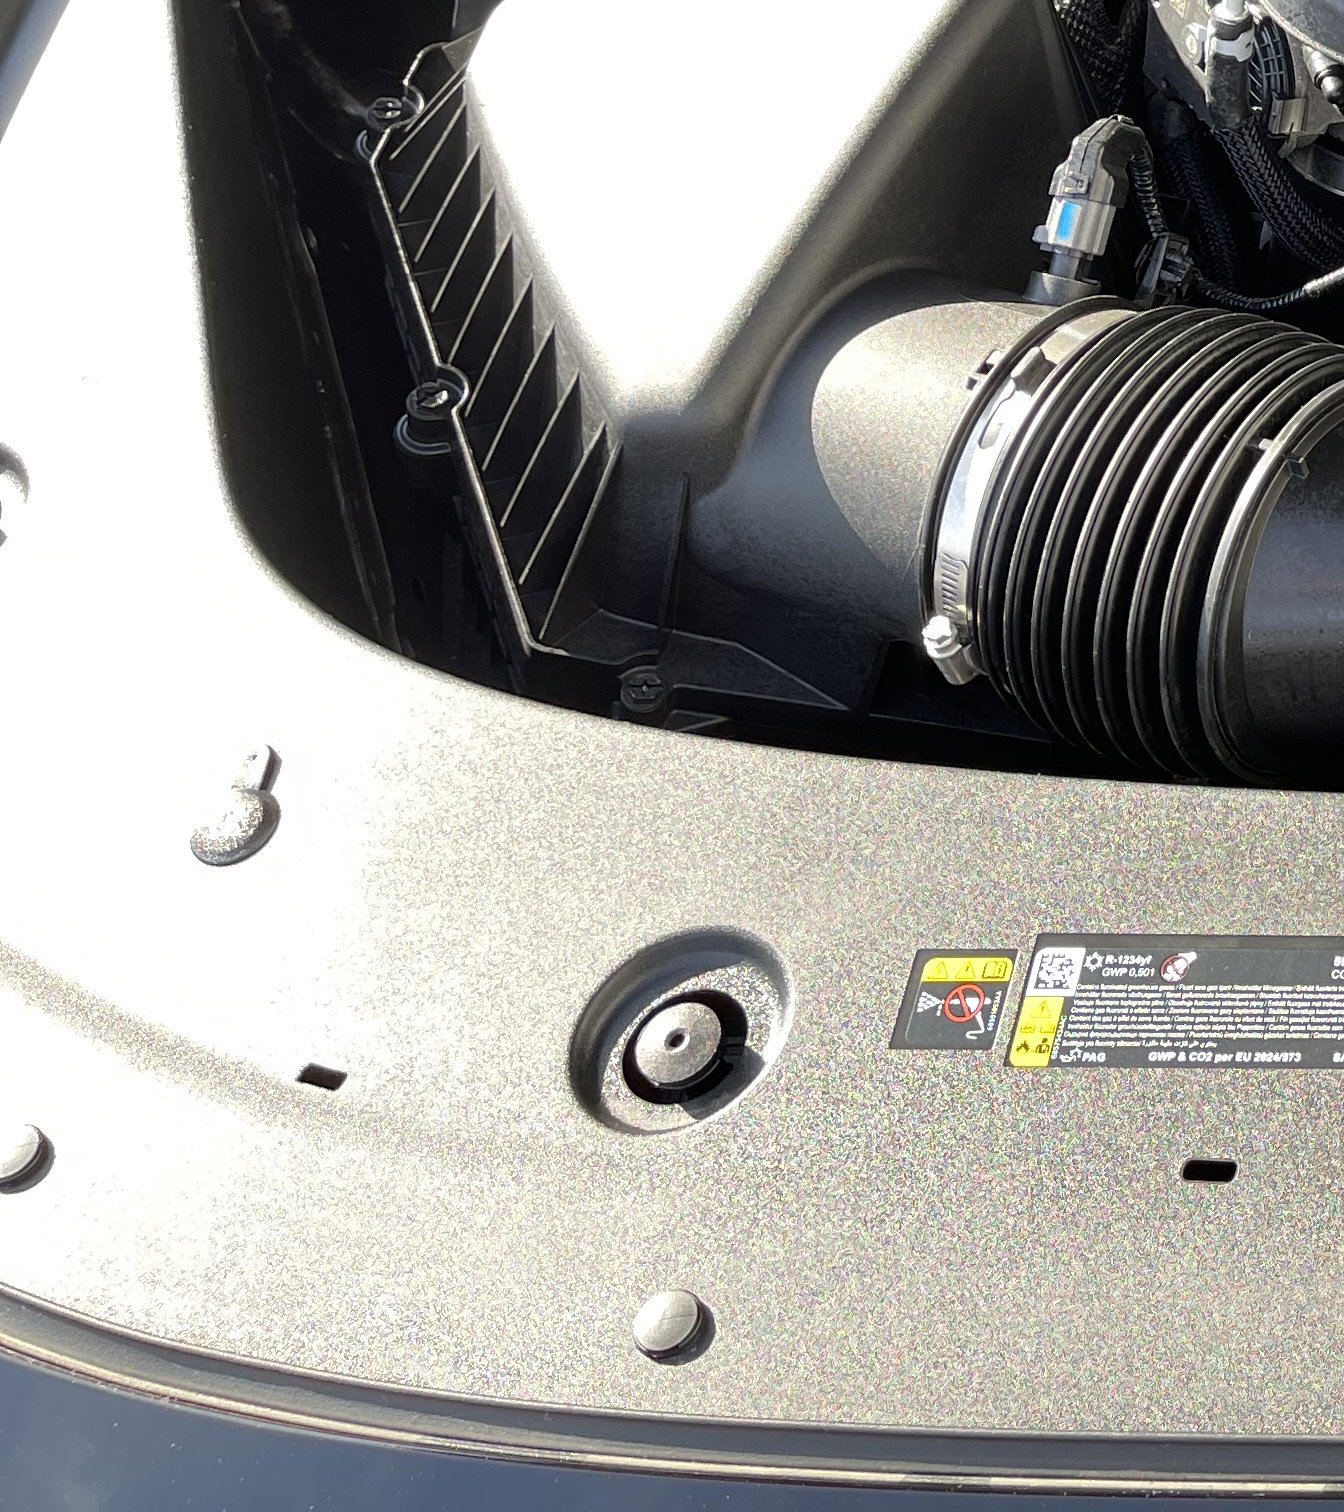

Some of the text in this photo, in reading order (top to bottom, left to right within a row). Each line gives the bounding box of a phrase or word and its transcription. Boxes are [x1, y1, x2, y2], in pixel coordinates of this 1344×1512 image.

[1104, 954, 1153, 967] R-1234yf
[1102, 968, 1127, 977] GWP
[1082, 1052, 1106, 1063] PAG
[1148, 1052, 1175, 1062] GWP
[1188, 1052, 1212, 1062] CO2
[1214, 1053, 1233, 1064] per
[1235, 1052, 1251, 1062] EU
